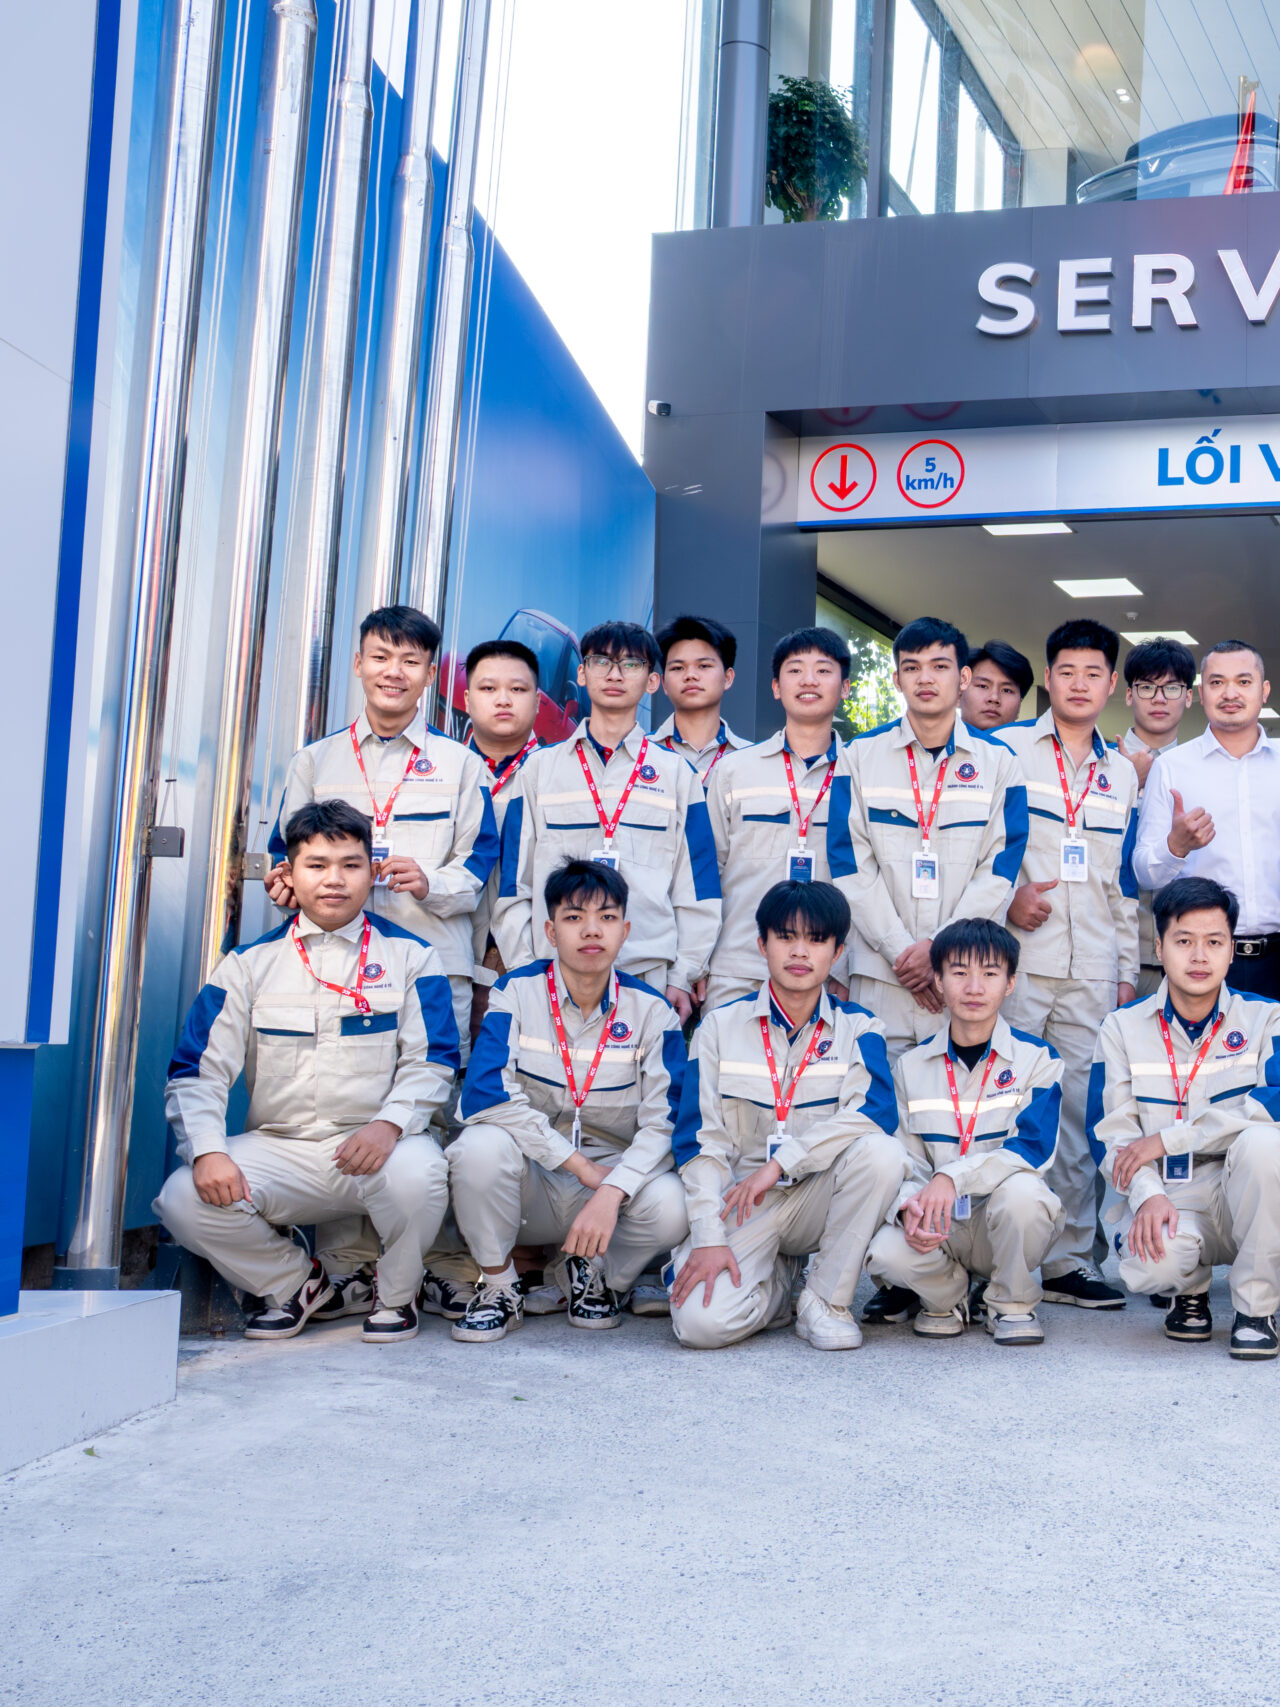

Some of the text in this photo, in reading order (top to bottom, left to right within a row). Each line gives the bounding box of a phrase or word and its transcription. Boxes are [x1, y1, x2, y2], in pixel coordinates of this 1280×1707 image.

[924, 457, 937, 473] 5
[1157, 428, 1242, 487] LỐI
[905, 471, 955, 492] km/h
